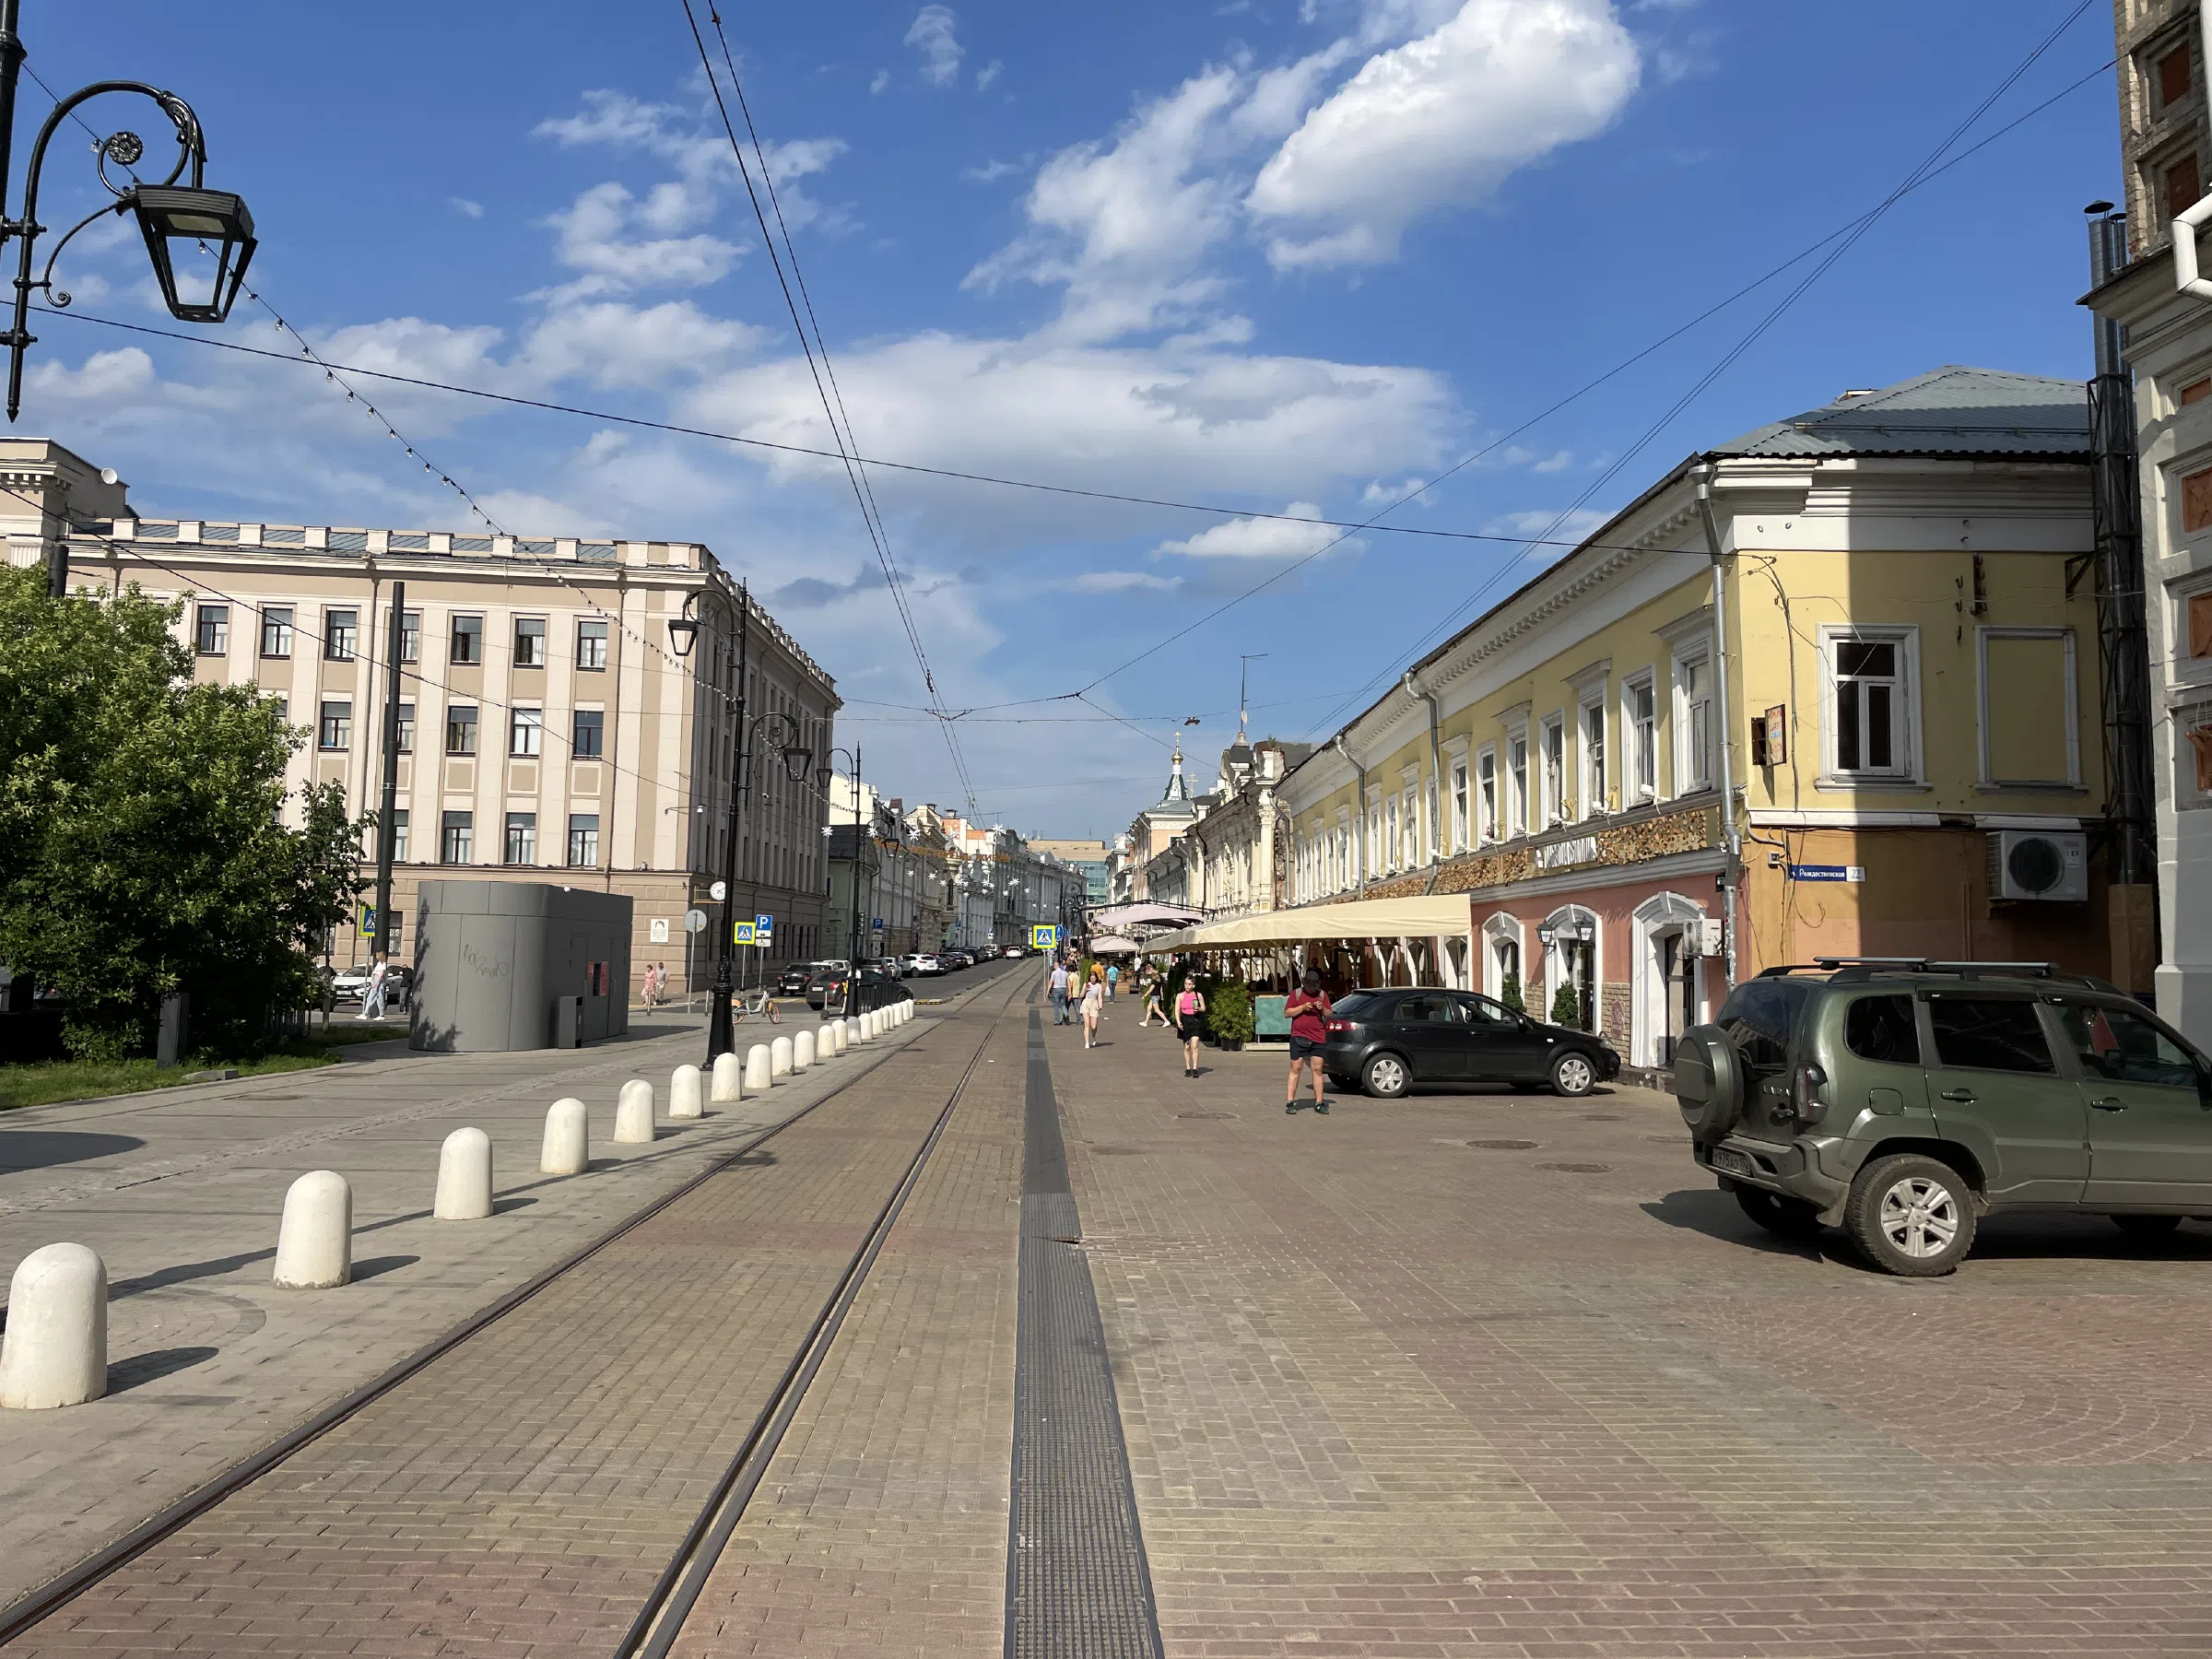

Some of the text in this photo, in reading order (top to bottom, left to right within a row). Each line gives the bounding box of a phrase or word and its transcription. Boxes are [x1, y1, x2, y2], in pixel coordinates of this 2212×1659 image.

[1799, 868, 1845, 878] Рождественская
[1851, 868, 1861, 879] 22
[759, 916, 769, 930] P
